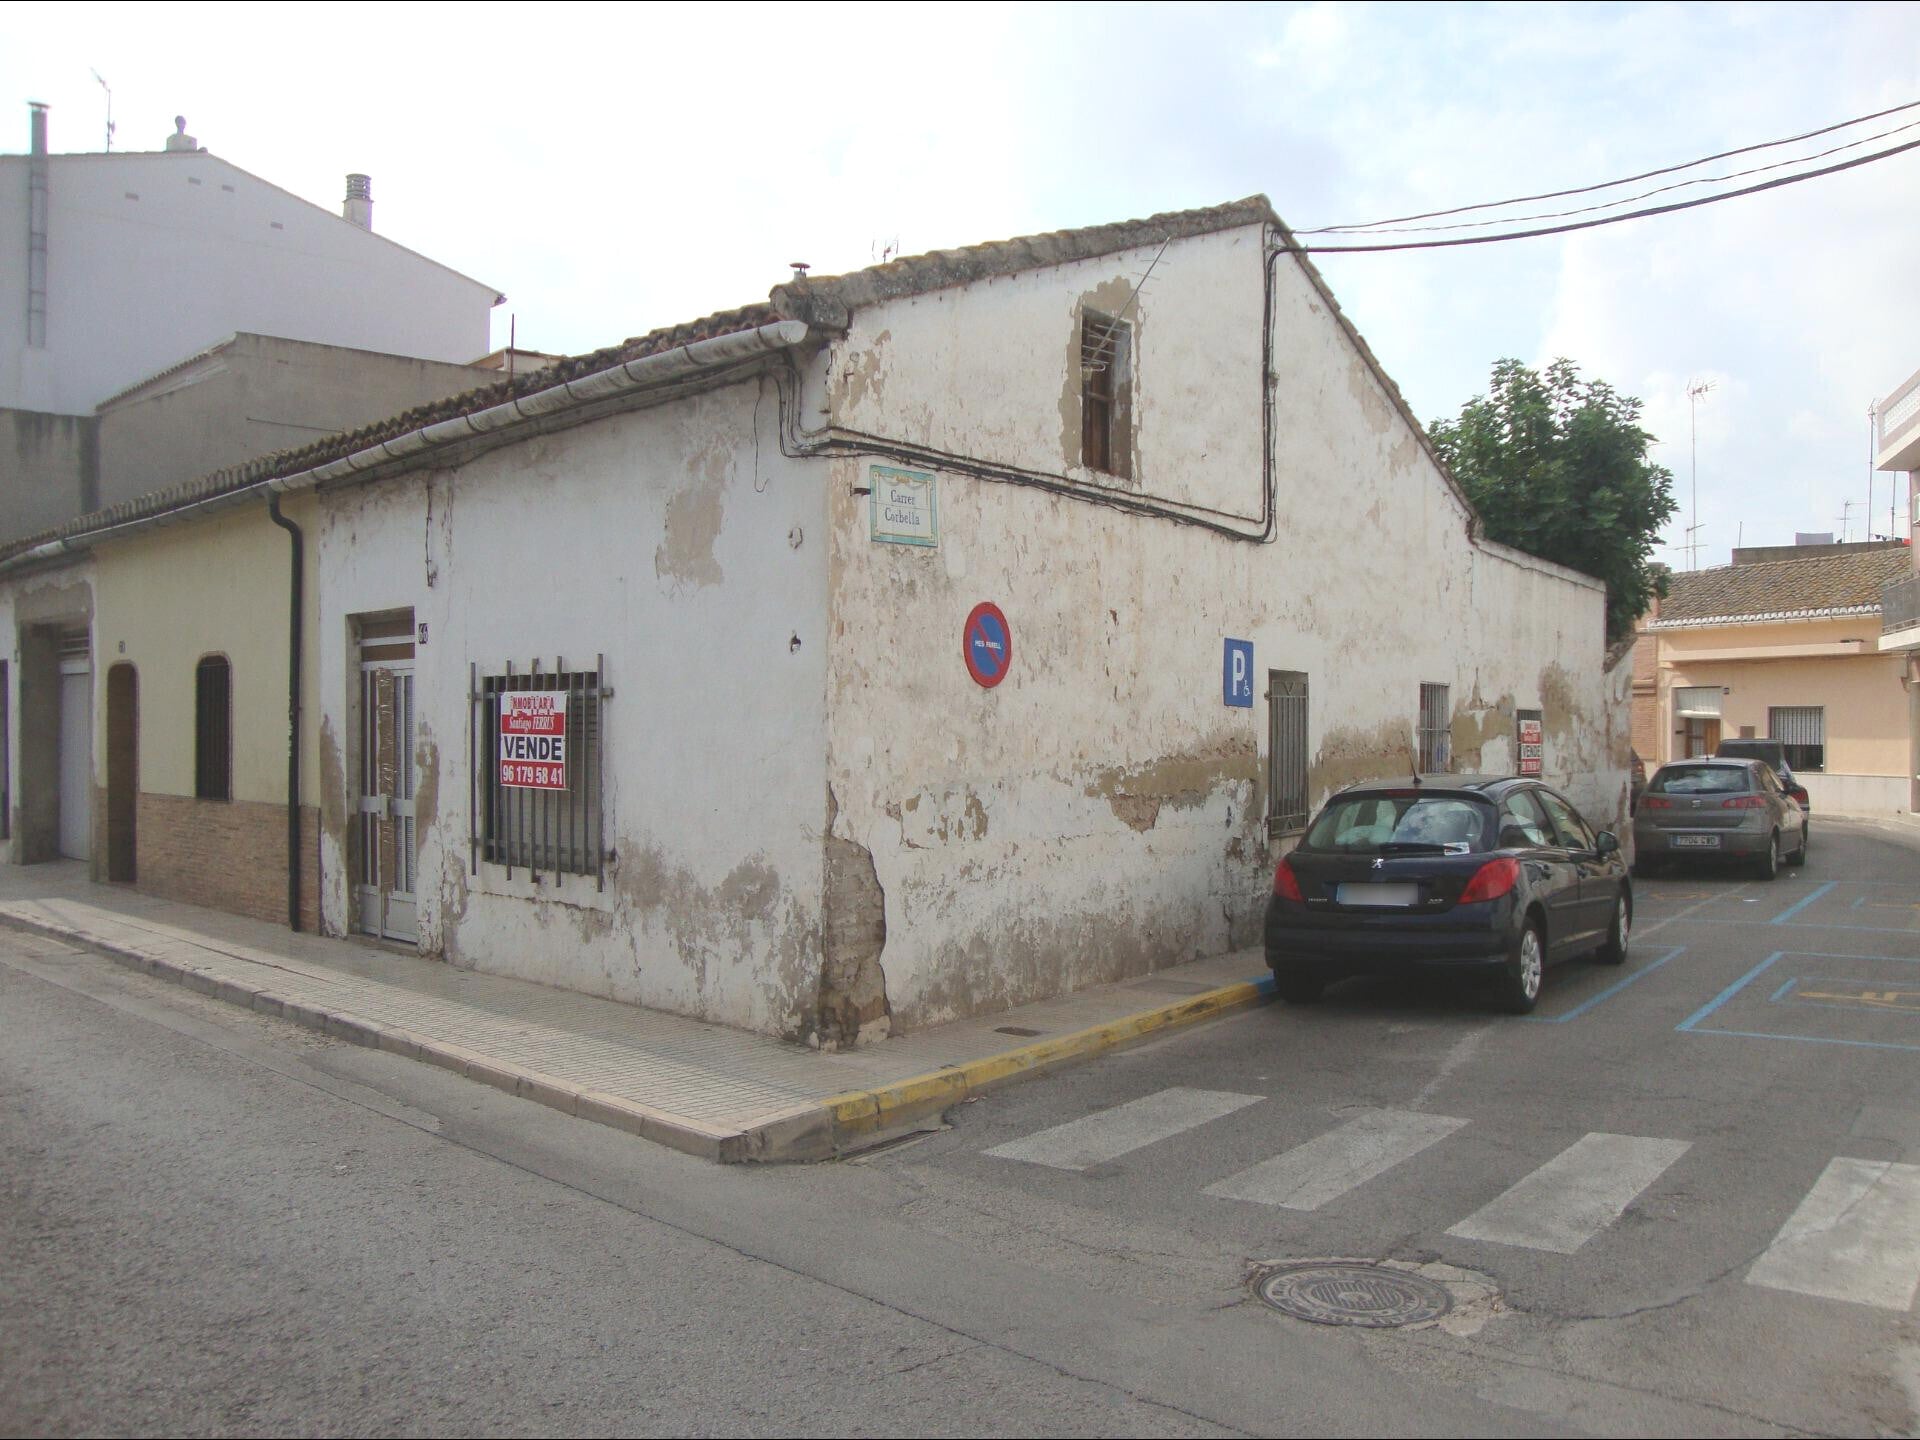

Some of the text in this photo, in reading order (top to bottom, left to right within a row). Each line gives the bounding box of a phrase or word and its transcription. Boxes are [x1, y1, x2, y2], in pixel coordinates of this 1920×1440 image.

[890, 489, 915, 505] Carrer
[884, 507, 920, 525] Corbella
[1232, 649, 1246, 696] P
[509, 716, 532, 733] Santiago
[504, 736, 562, 760] VENDE
[502, 765, 563, 785] 96 179 58 41
